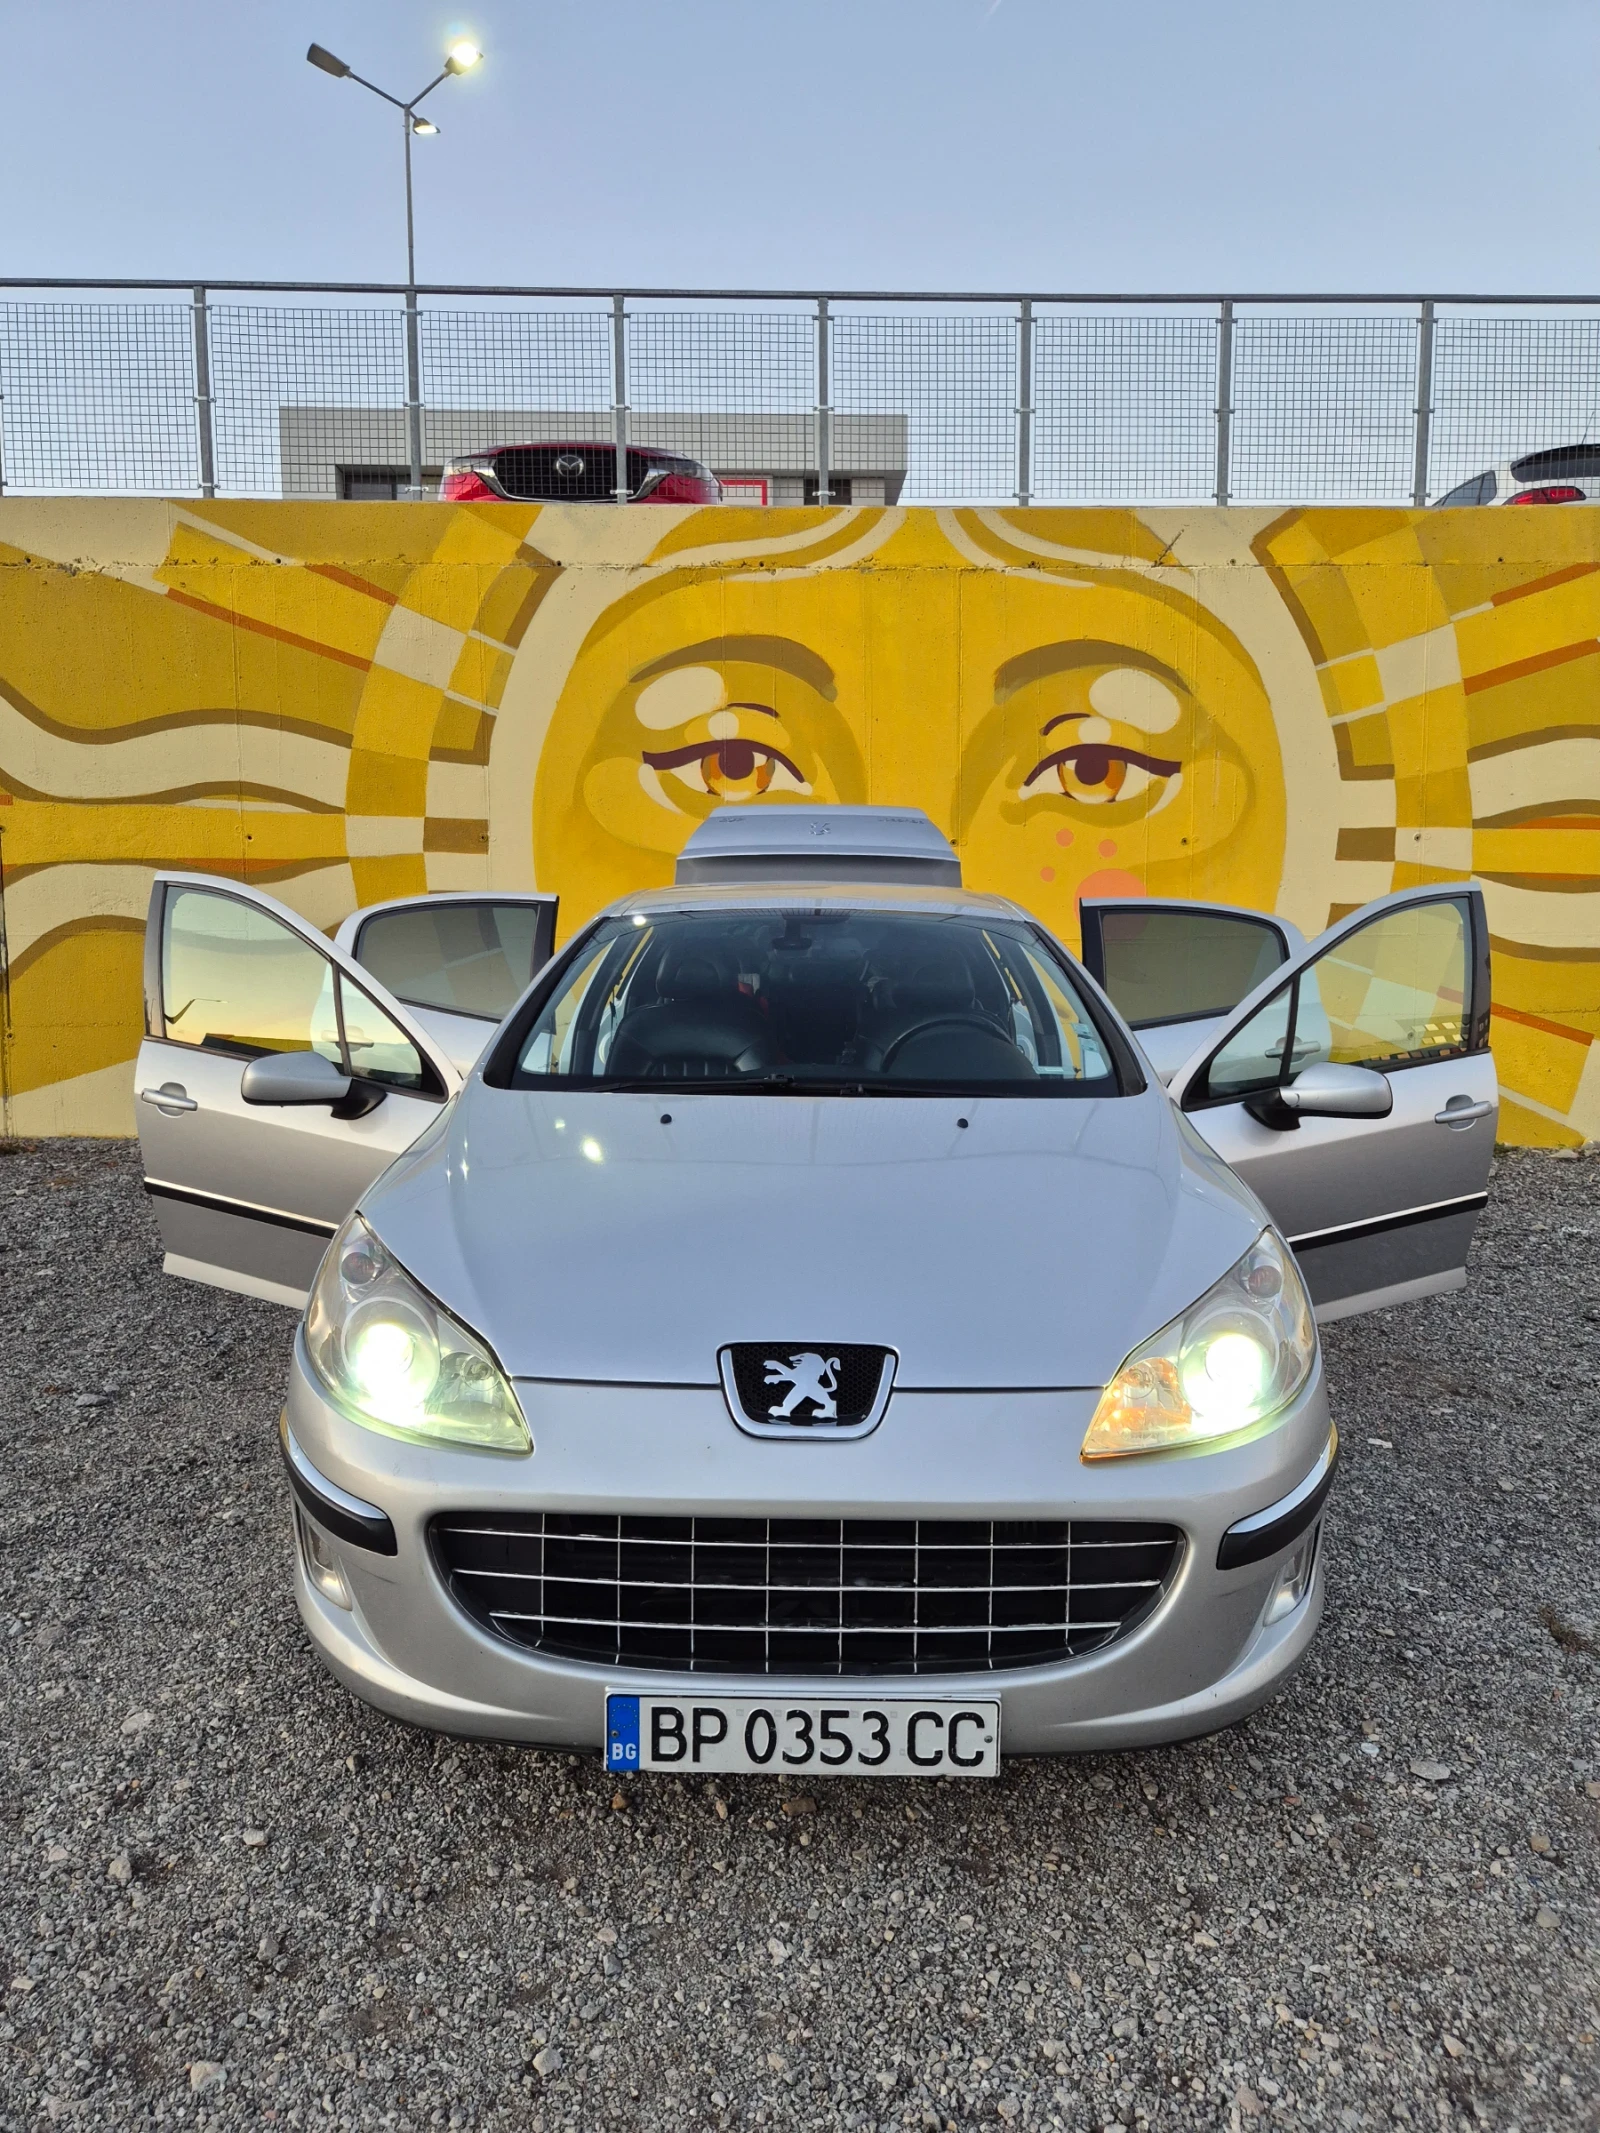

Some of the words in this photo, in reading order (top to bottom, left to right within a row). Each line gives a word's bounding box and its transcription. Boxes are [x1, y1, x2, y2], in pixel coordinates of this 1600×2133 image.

[612, 1743, 637, 1759] BG
[651, 1706, 728, 1763] BP
[744, 1708, 892, 1766] 0353
[907, 1711, 985, 1767] CC
